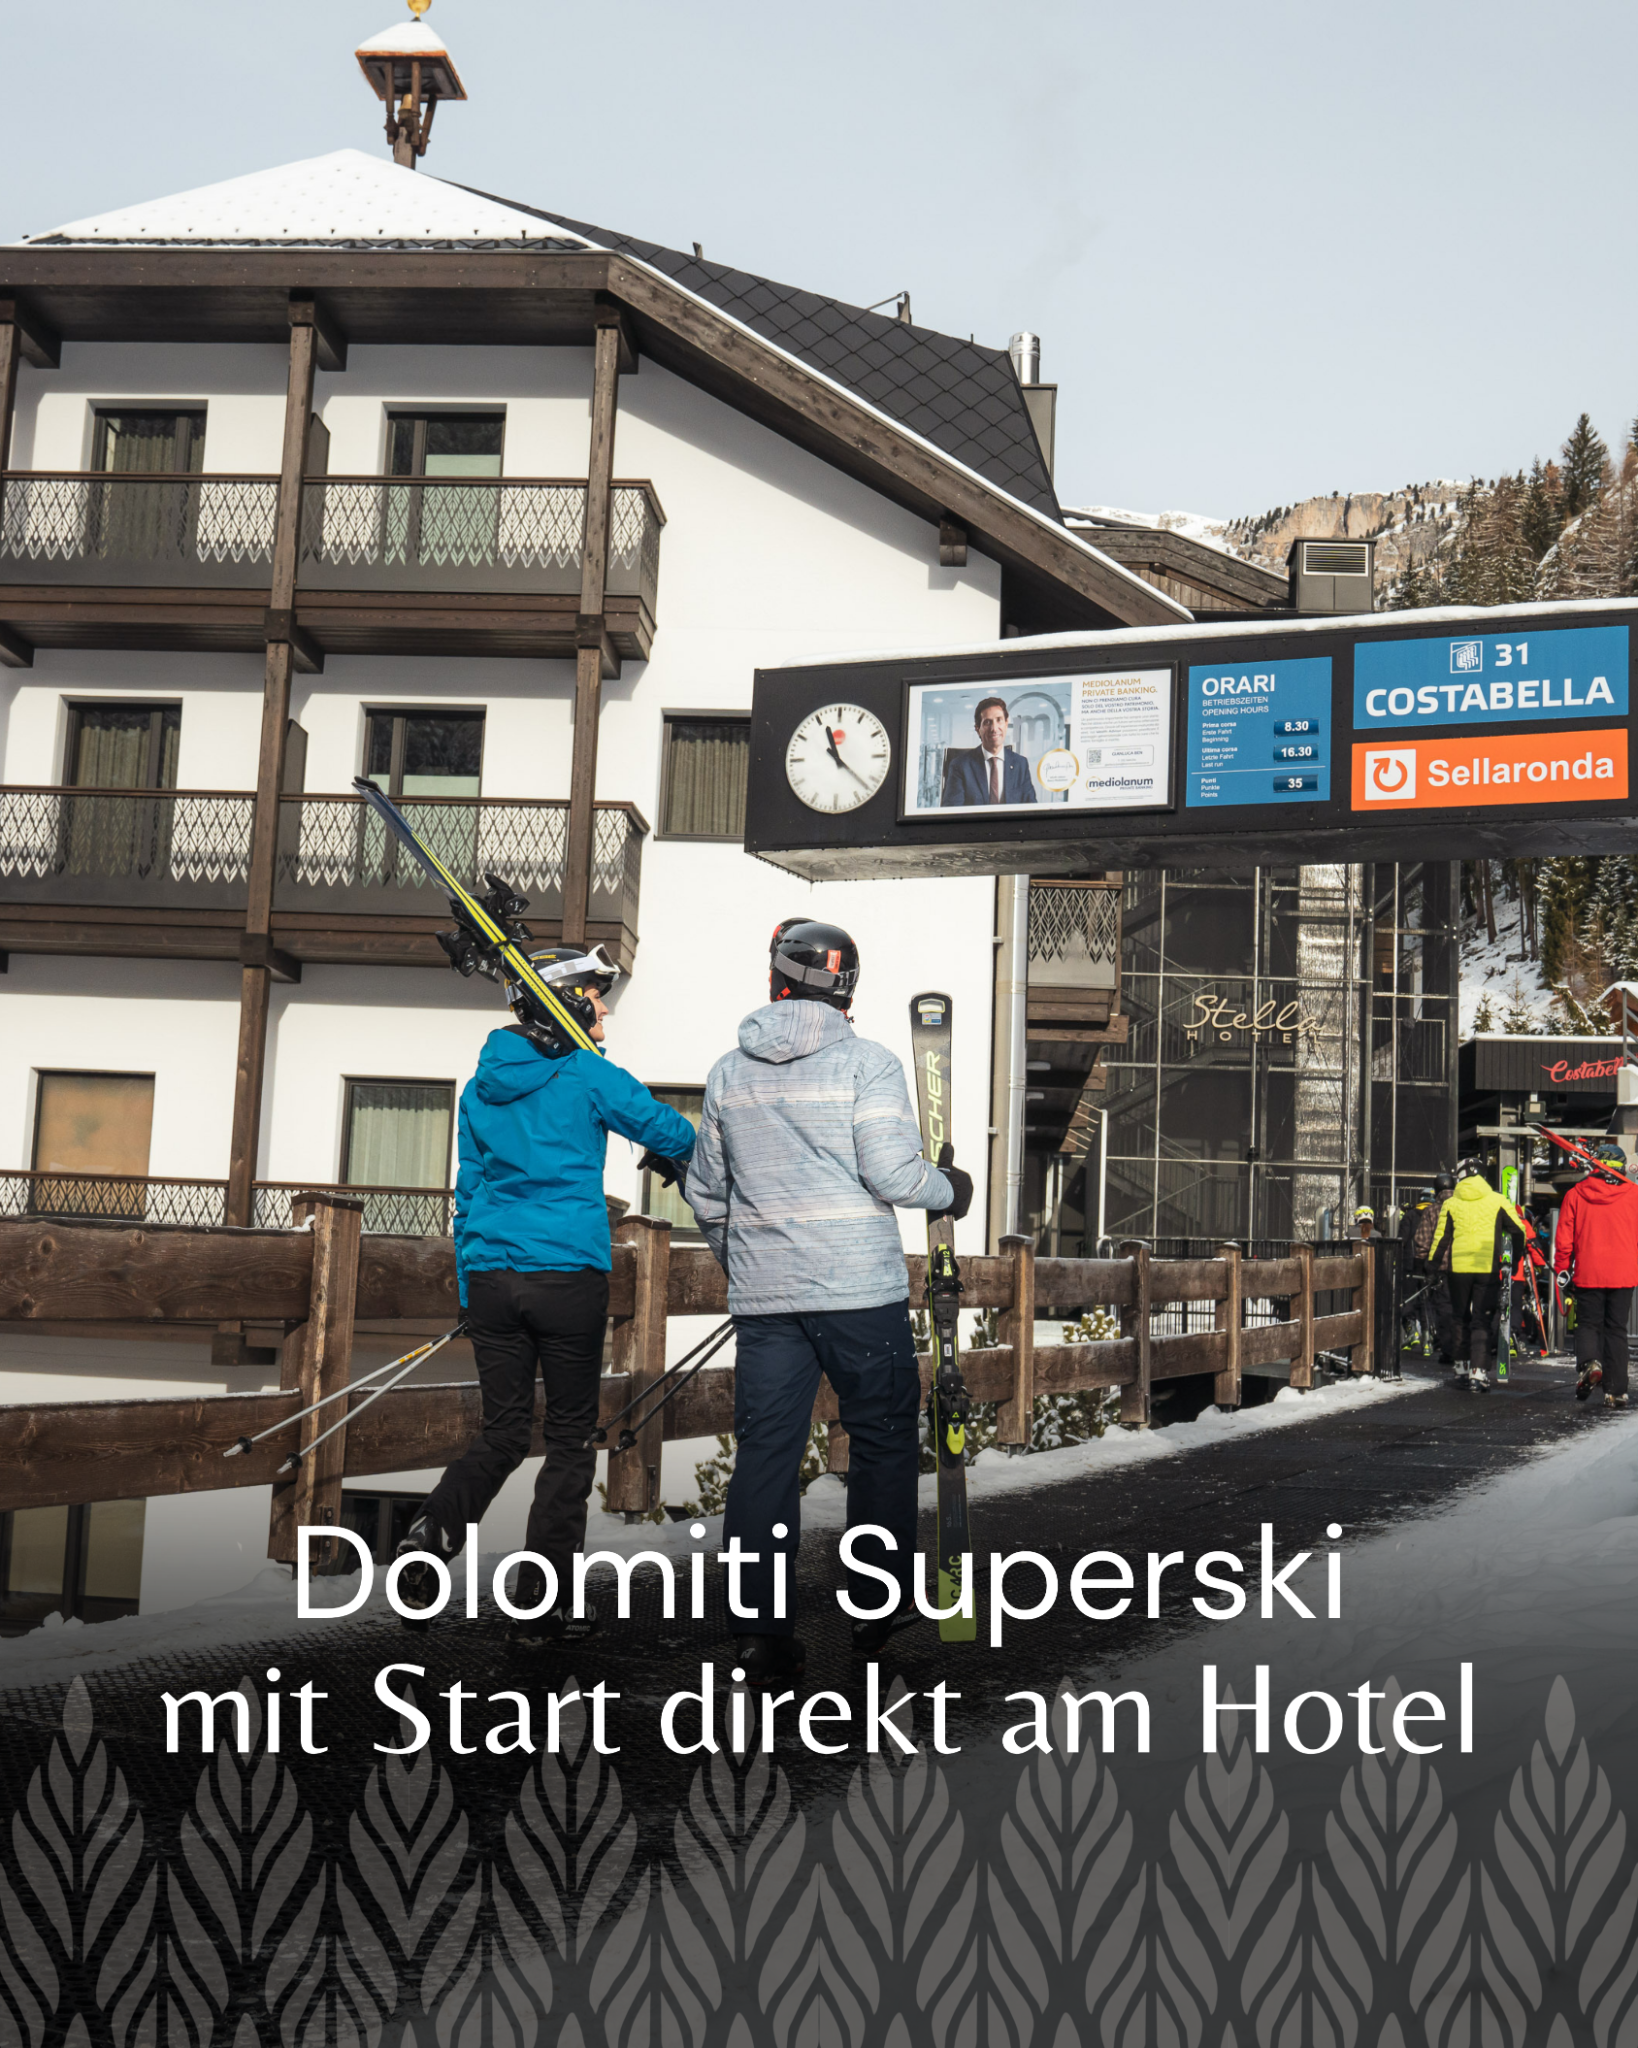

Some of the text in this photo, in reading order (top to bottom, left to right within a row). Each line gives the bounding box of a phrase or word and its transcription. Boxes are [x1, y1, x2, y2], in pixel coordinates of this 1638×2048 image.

[1494, 642, 1528, 667] 31
[1082, 678, 1141, 688] MEDIOLANUM
[1202, 674, 1275, 696] ORARI
[1082, 686, 1158, 697] PRIVATE BANKING.
[1365, 676, 1615, 717] COSTABELLA
[1202, 696, 1269, 707] BETRIEBSZEITEN
[1202, 706, 1269, 716] OPENING HOURS
[1284, 721, 1309, 732] 8.30
[1281, 746, 1312, 758] 16.30
[1428, 752, 1614, 787] Sellaronda
[1088, 776, 1153, 788] mediolanum
[1288, 778, 1302, 788] 35
[1183, 995, 1326, 1031] Stella
[1186, 1030, 1322, 1044] HOTEL
[1540, 1056, 1630, 1083] Costabell
[926, 1050, 944, 1168] SCHER
